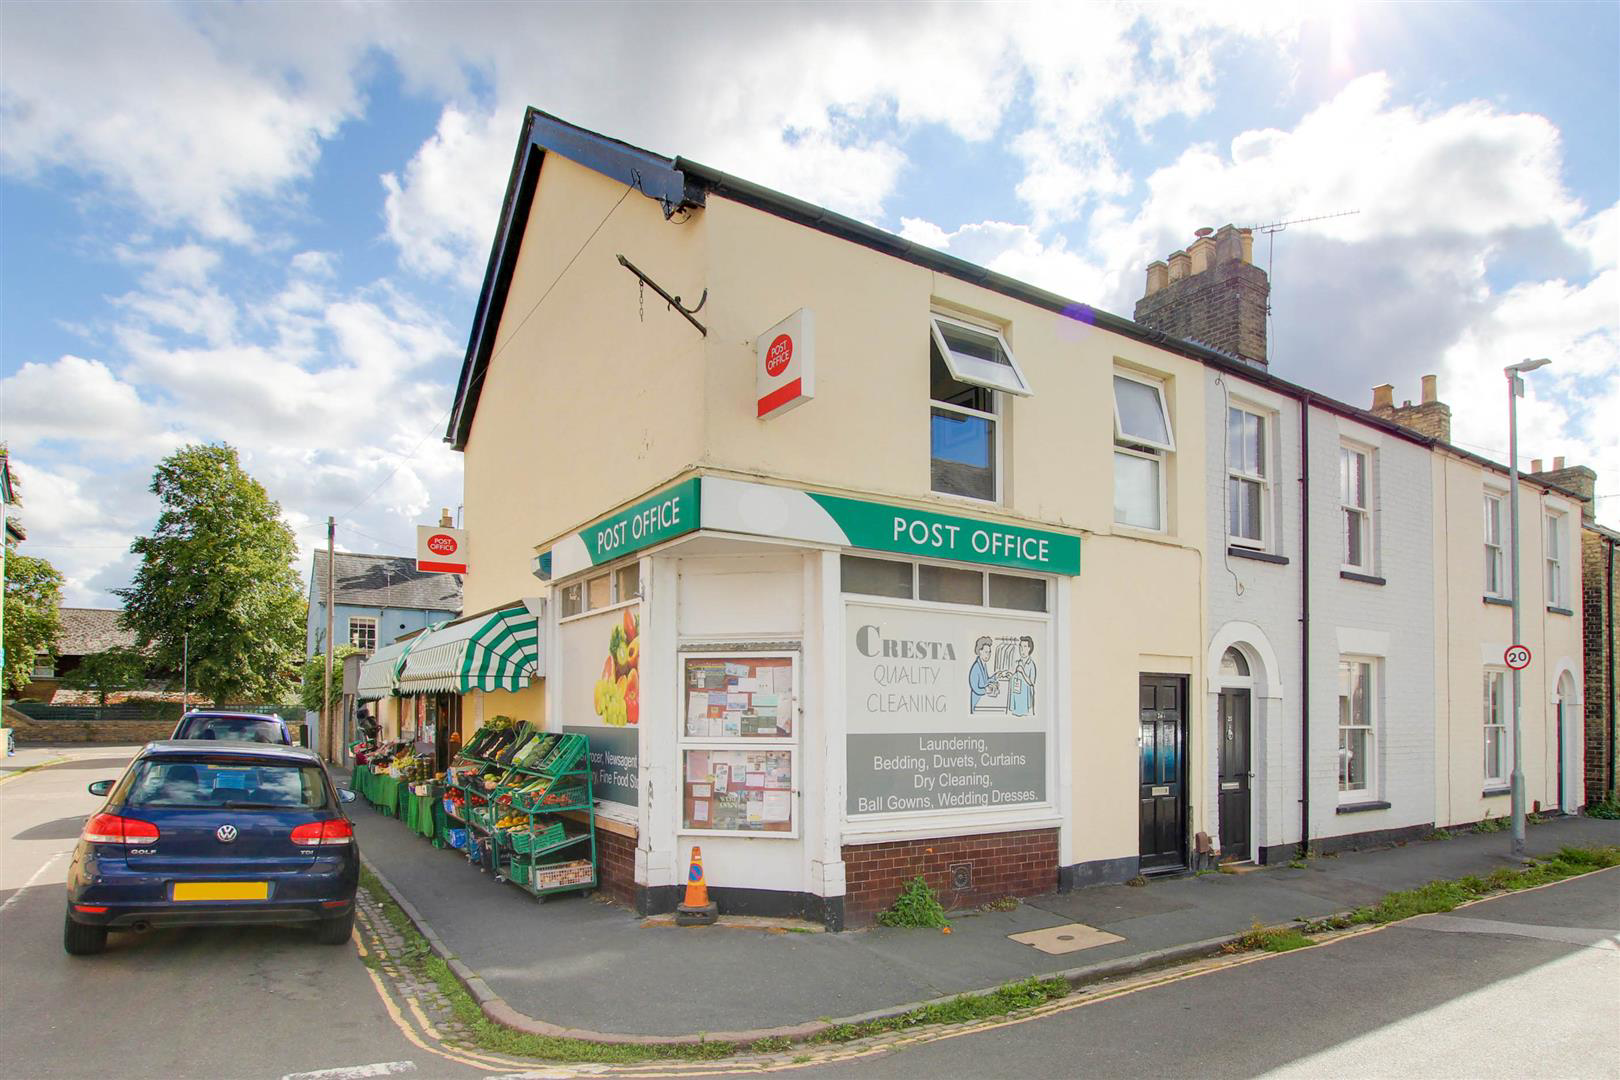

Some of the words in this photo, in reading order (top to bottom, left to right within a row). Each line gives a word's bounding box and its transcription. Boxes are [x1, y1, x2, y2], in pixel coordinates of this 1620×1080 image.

[771, 340, 787, 358] POST
[767, 350, 790, 370] OFFICE
[598, 520, 628, 554] POST
[632, 496, 680, 540] OFFICE
[893, 517, 960, 549] POST
[971, 530, 1049, 562] OFFICE
[856, 624, 957, 661] CRESTA
[1508, 651, 1527, 663] 20
[873, 664, 941, 687] QUALITY
[866, 693, 947, 713] CLEANING
[919, 737, 988, 753] Laundering,
[873, 755, 930, 772] Bedding,
[933, 754, 977, 769] Duvets,
[980, 752, 1026, 767] Curtains
[599, 769, 612, 784] Fine
[613, 771, 629, 788] Food
[914, 775, 935, 791] Dry
[939, 772, 993, 788] Cleaning,
[858, 797, 883, 812] Ball
[887, 795, 934, 810] Gowns,
[937, 791, 989, 807] Wedding
[992, 788, 1039, 803] Dresses.
